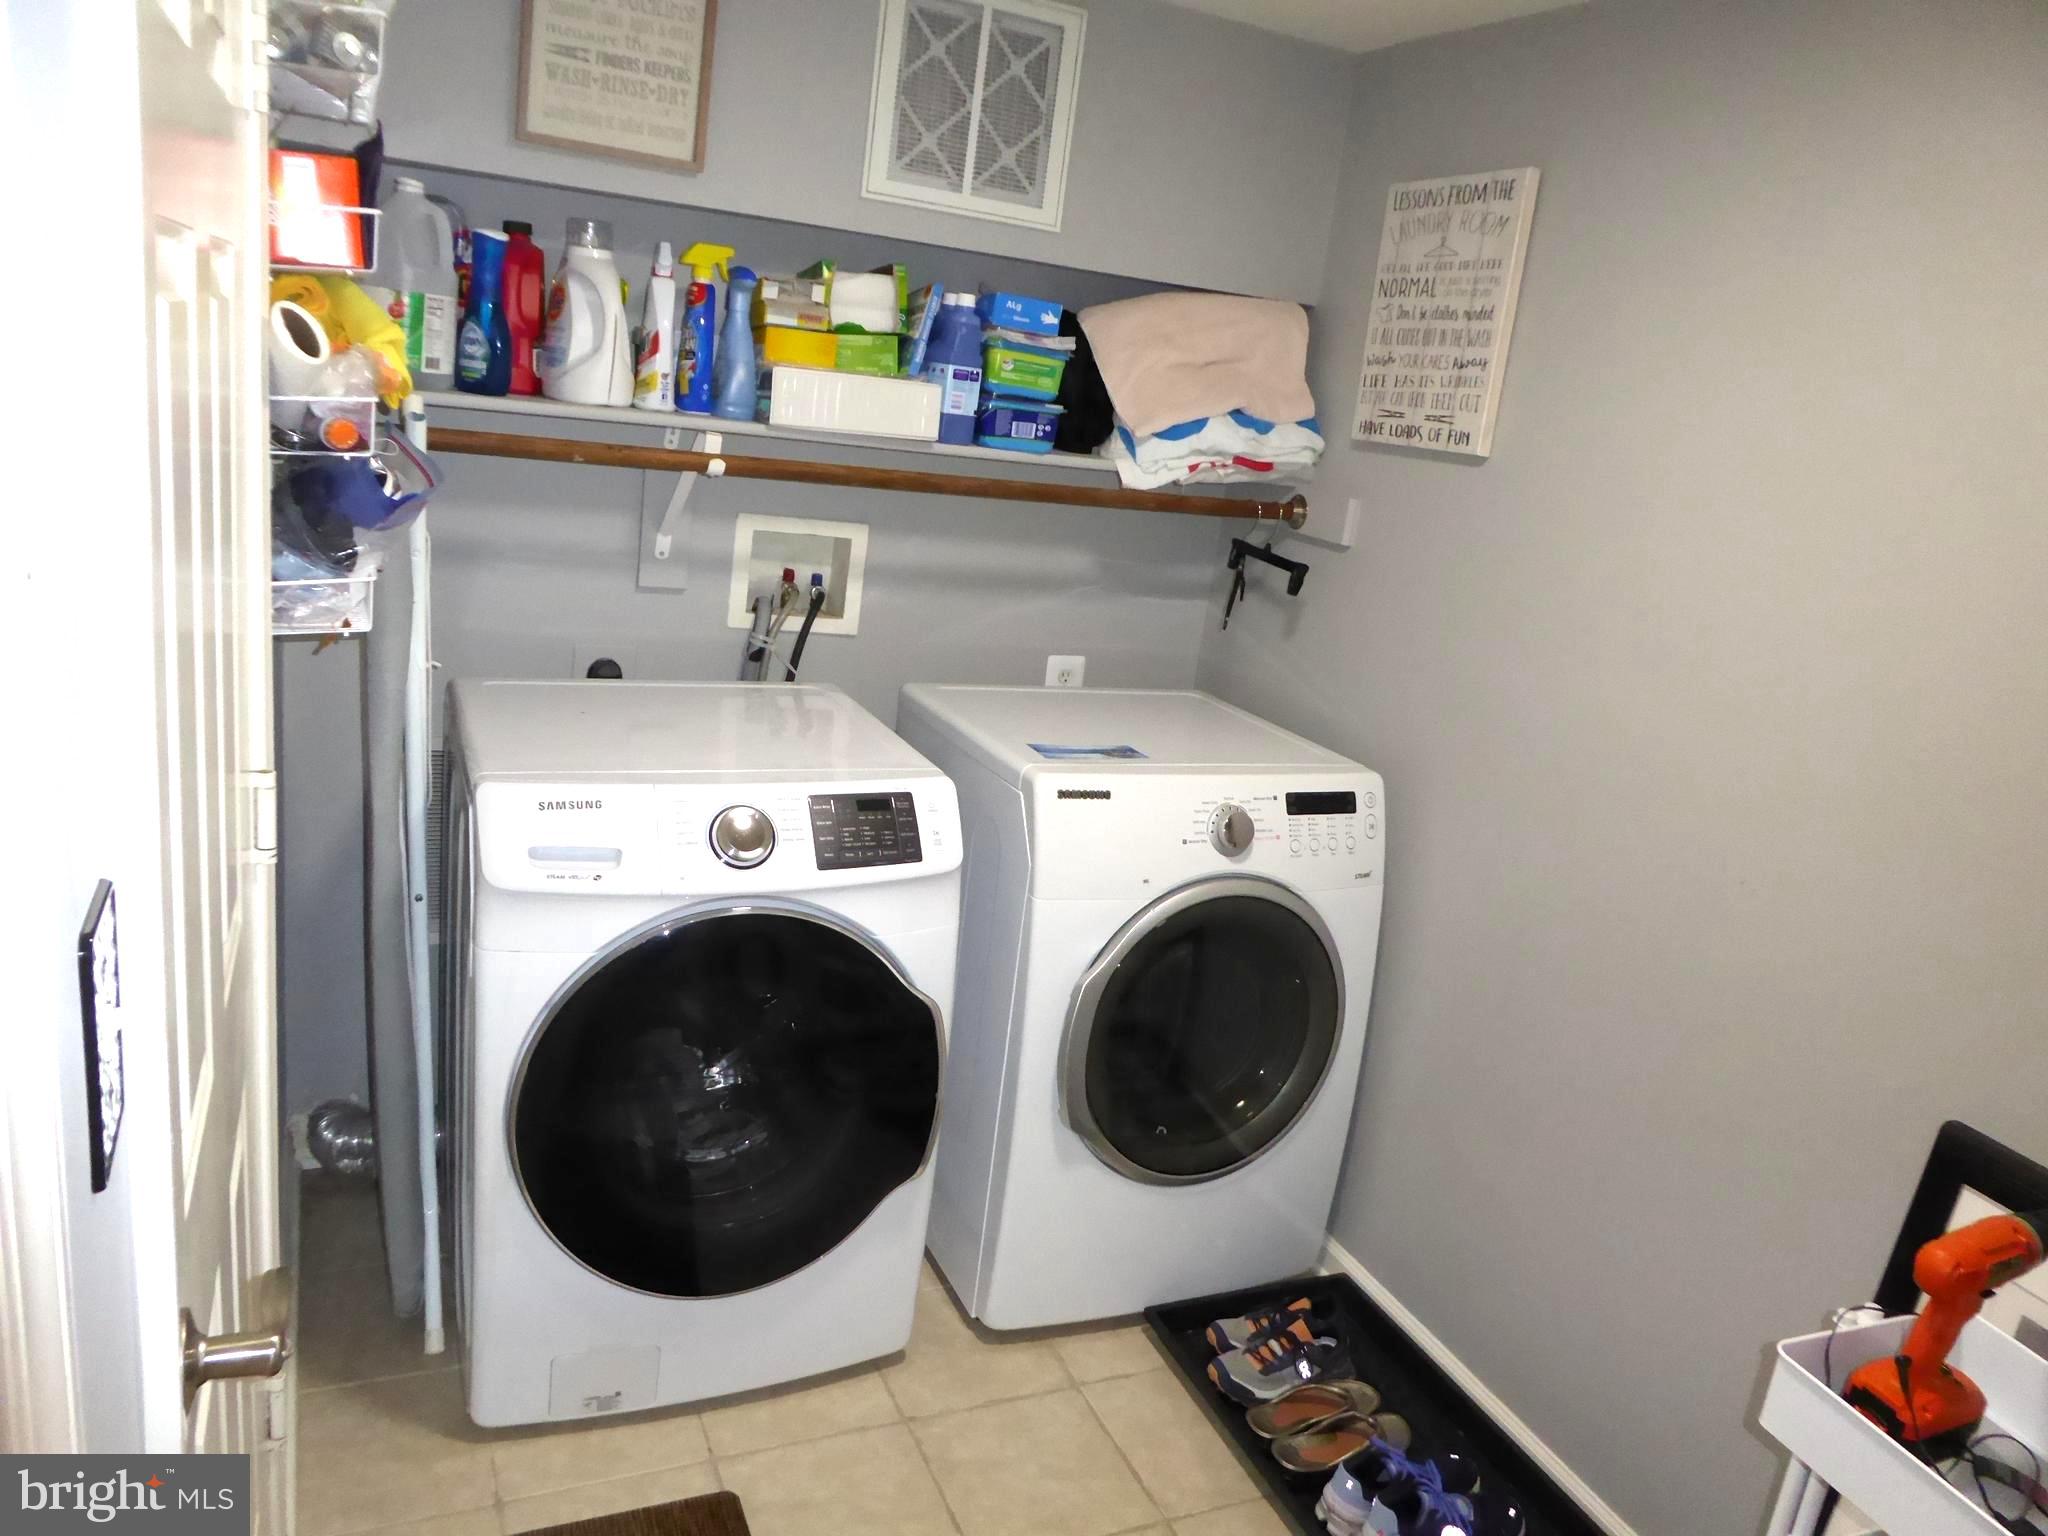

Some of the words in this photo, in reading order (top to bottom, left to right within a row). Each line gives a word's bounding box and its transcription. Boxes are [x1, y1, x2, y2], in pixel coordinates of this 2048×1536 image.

[644, 60, 692, 83] KEEPERS
[545, 62, 592, 89] WASH
[600, 72, 649, 100] RINSE
[655, 83, 689, 106] DRY
[1393, 187, 1445, 212] LESSONS
[1448, 182, 1489, 207] FROM
[1493, 178, 1516, 201] THE
[1390, 210, 1452, 245] LAUNDRY
[1459, 210, 1510, 238] ROOM
[1378, 276, 1437, 299] NORMAL
[1366, 351, 1397, 368] Wash
[1399, 353, 1420, 369] YOUR
[1420, 353, 1450, 370] CARES
[1362, 373, 1387, 388] LIFE
[1359, 420, 1385, 436] HAVE
[1389, 423, 1424, 442] LOADS
[1427, 428, 1443, 442] OF
[1447, 430, 1471, 447] FUN
[538, 800, 603, 811] SAMSUNG
